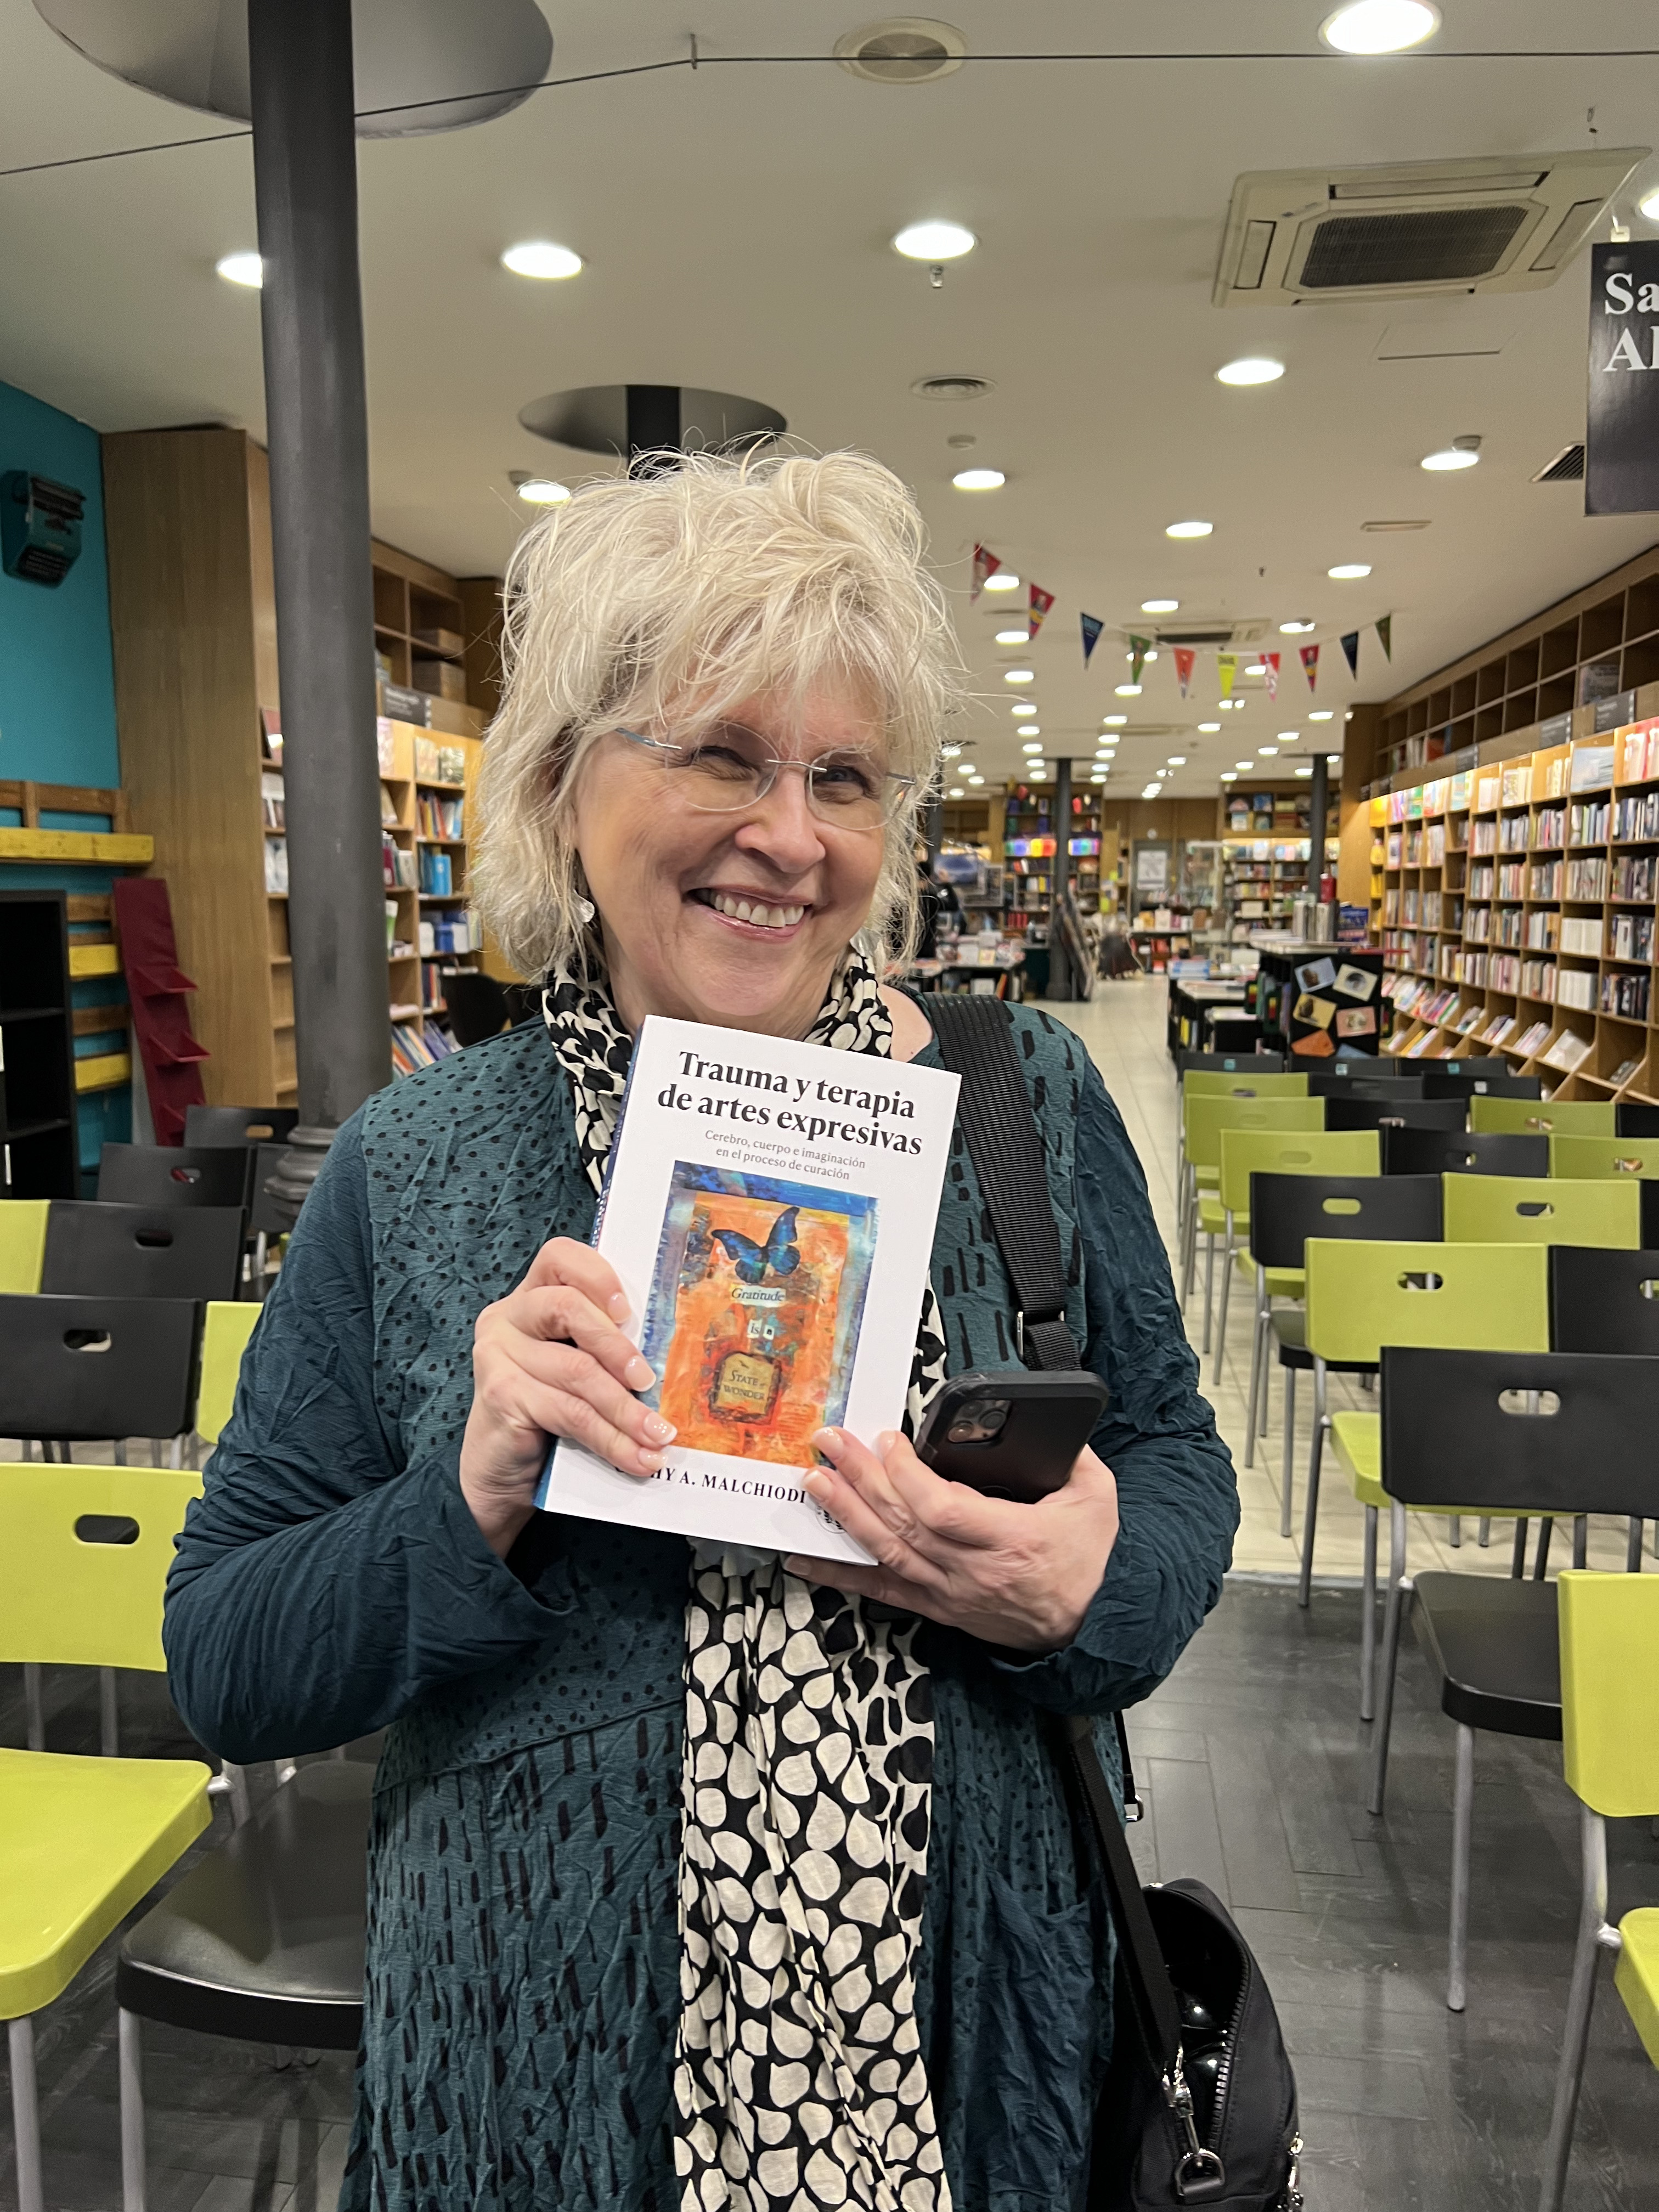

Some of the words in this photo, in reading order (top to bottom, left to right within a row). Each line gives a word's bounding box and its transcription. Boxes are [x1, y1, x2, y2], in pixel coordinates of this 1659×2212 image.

[679, 1051, 788, 1093] Trauma
[793, 1079, 811, 1103] y
[817, 1079, 915, 1119] terapia
[658, 1084, 692, 1110] de
[698, 1097, 770, 1125] artes
[777, 1111, 922, 1155] expresivas
[705, 1130, 751, 1148] Cerebro,
[753, 1141, 791, 1155] cuerpo
[802, 1147, 866, 1169] imaginación
[716, 1148, 729, 1157] en
[731, 1149, 741, 1159] el
[743, 1154, 786, 1168] proceso
[788, 1159, 802, 1171] de
[804, 1164, 850, 1180] curación
[731, 1287, 785, 1302] Gratitude
[724, 1384, 765, 1401] WONDER
[679, 1471, 696, 1485] A.
[702, 1474, 807, 1504] MALCHIODI
